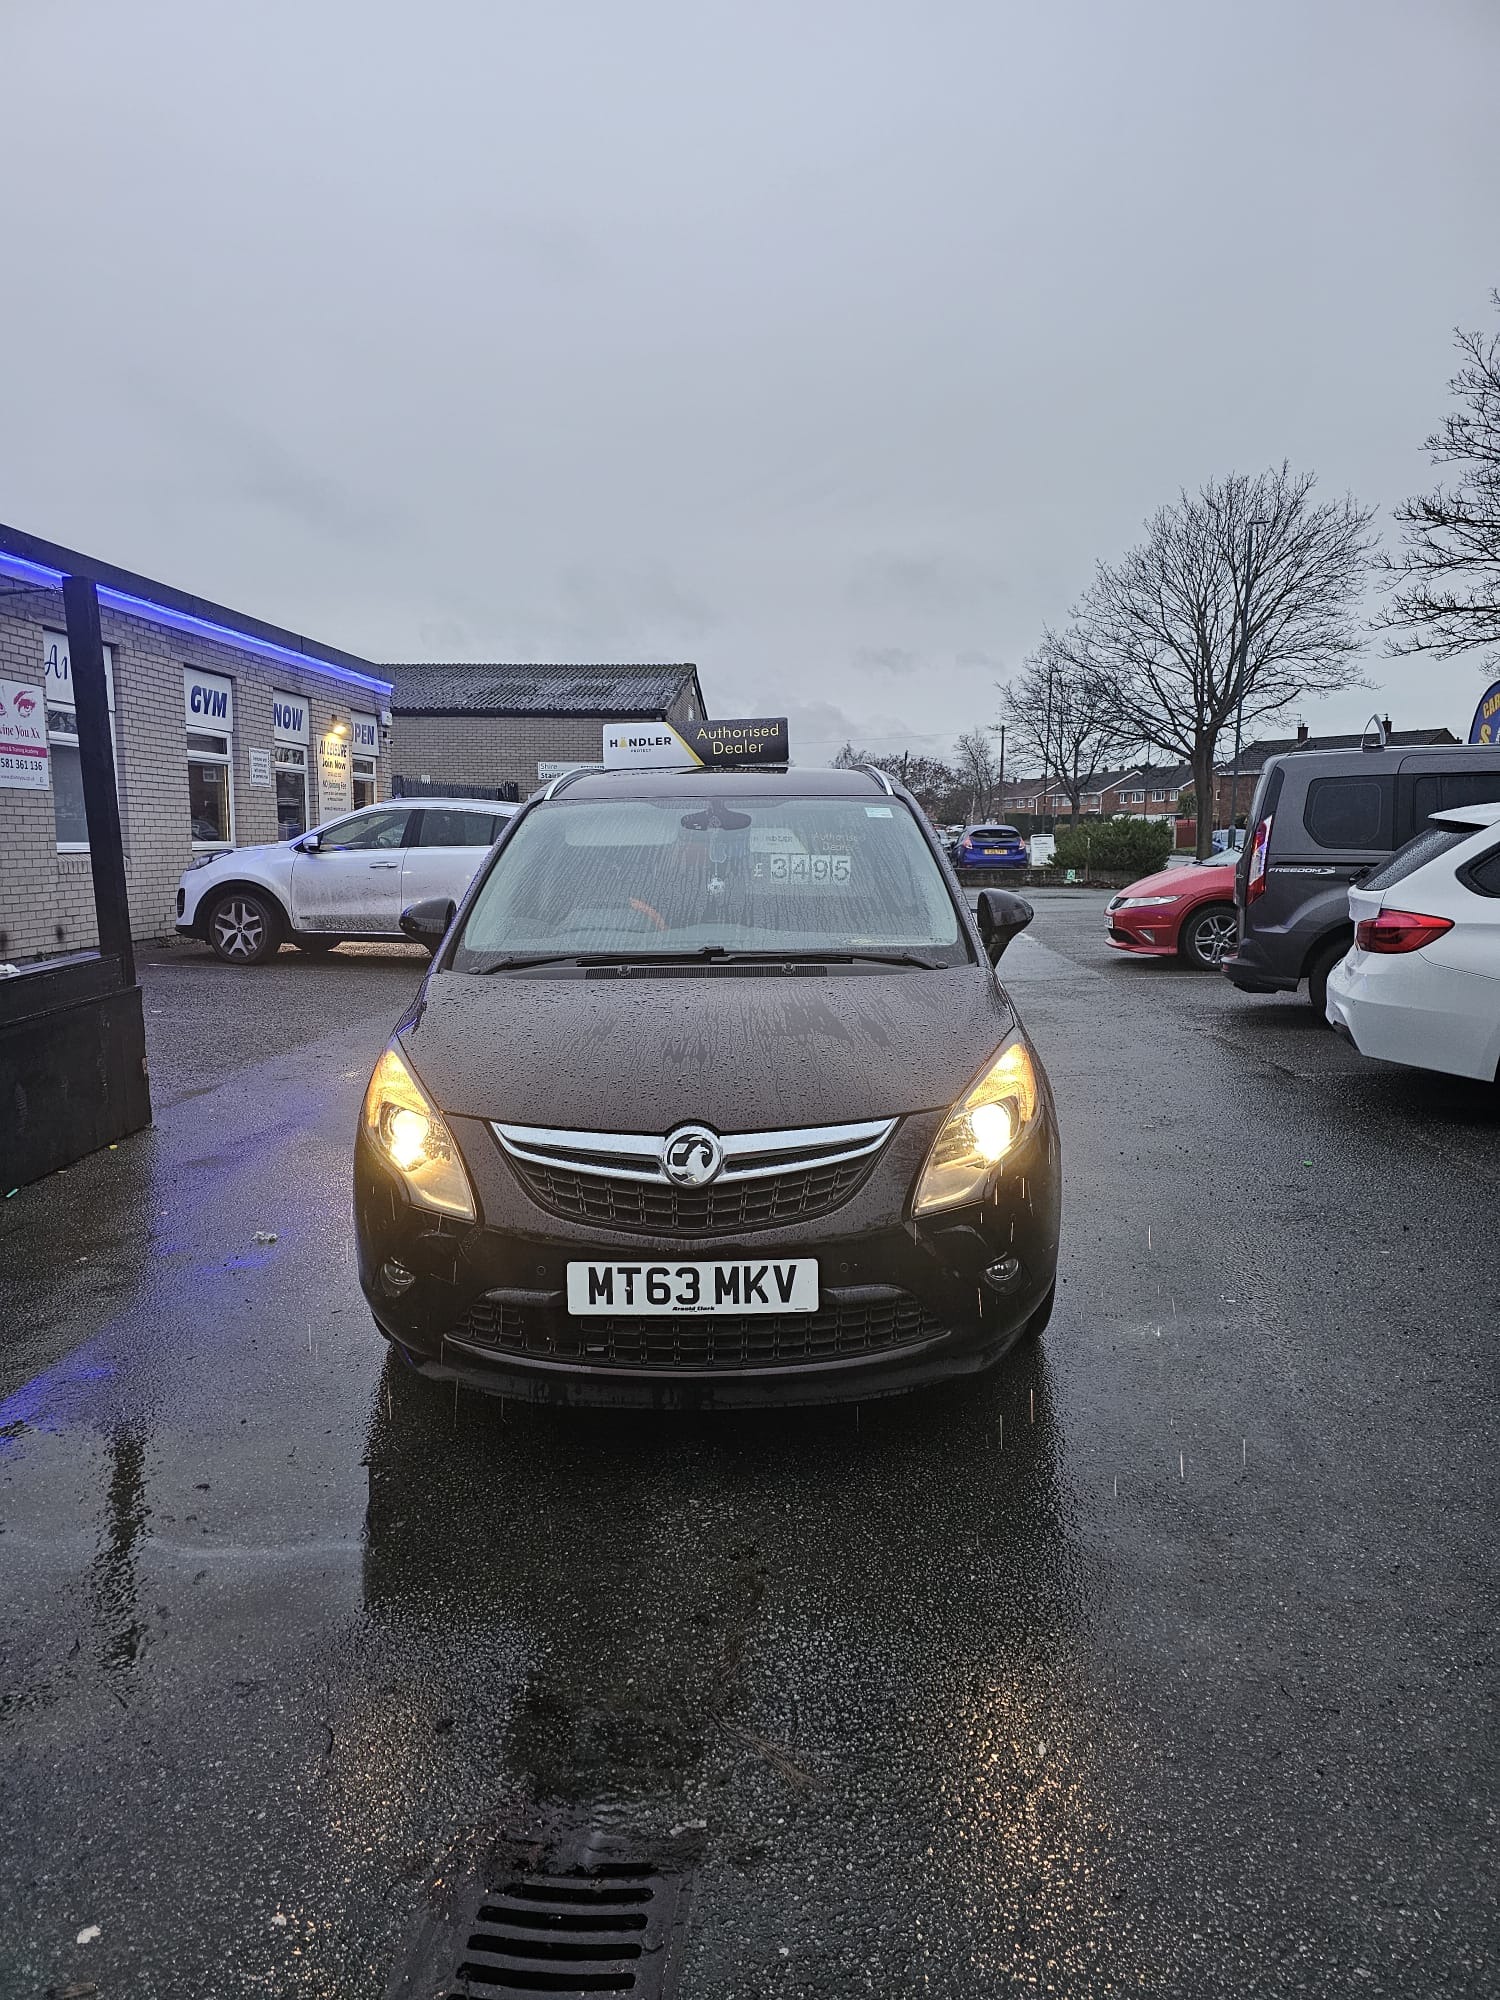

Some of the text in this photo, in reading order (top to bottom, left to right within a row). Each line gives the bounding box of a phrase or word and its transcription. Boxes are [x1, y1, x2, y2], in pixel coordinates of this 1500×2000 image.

[190, 685, 228, 718] GYM
[273, 702, 303, 731] NOW
[15, 724, 30, 740] You
[696, 723, 779, 740] Authorised
[712, 739, 764, 755] Dealer
[15, 759, 29, 770] 361
[30, 760, 43, 771] 136
[322, 757, 334, 769] Join
[772, 858, 849, 881] 3495
[588, 1264, 798, 1306] MT63 MKV
